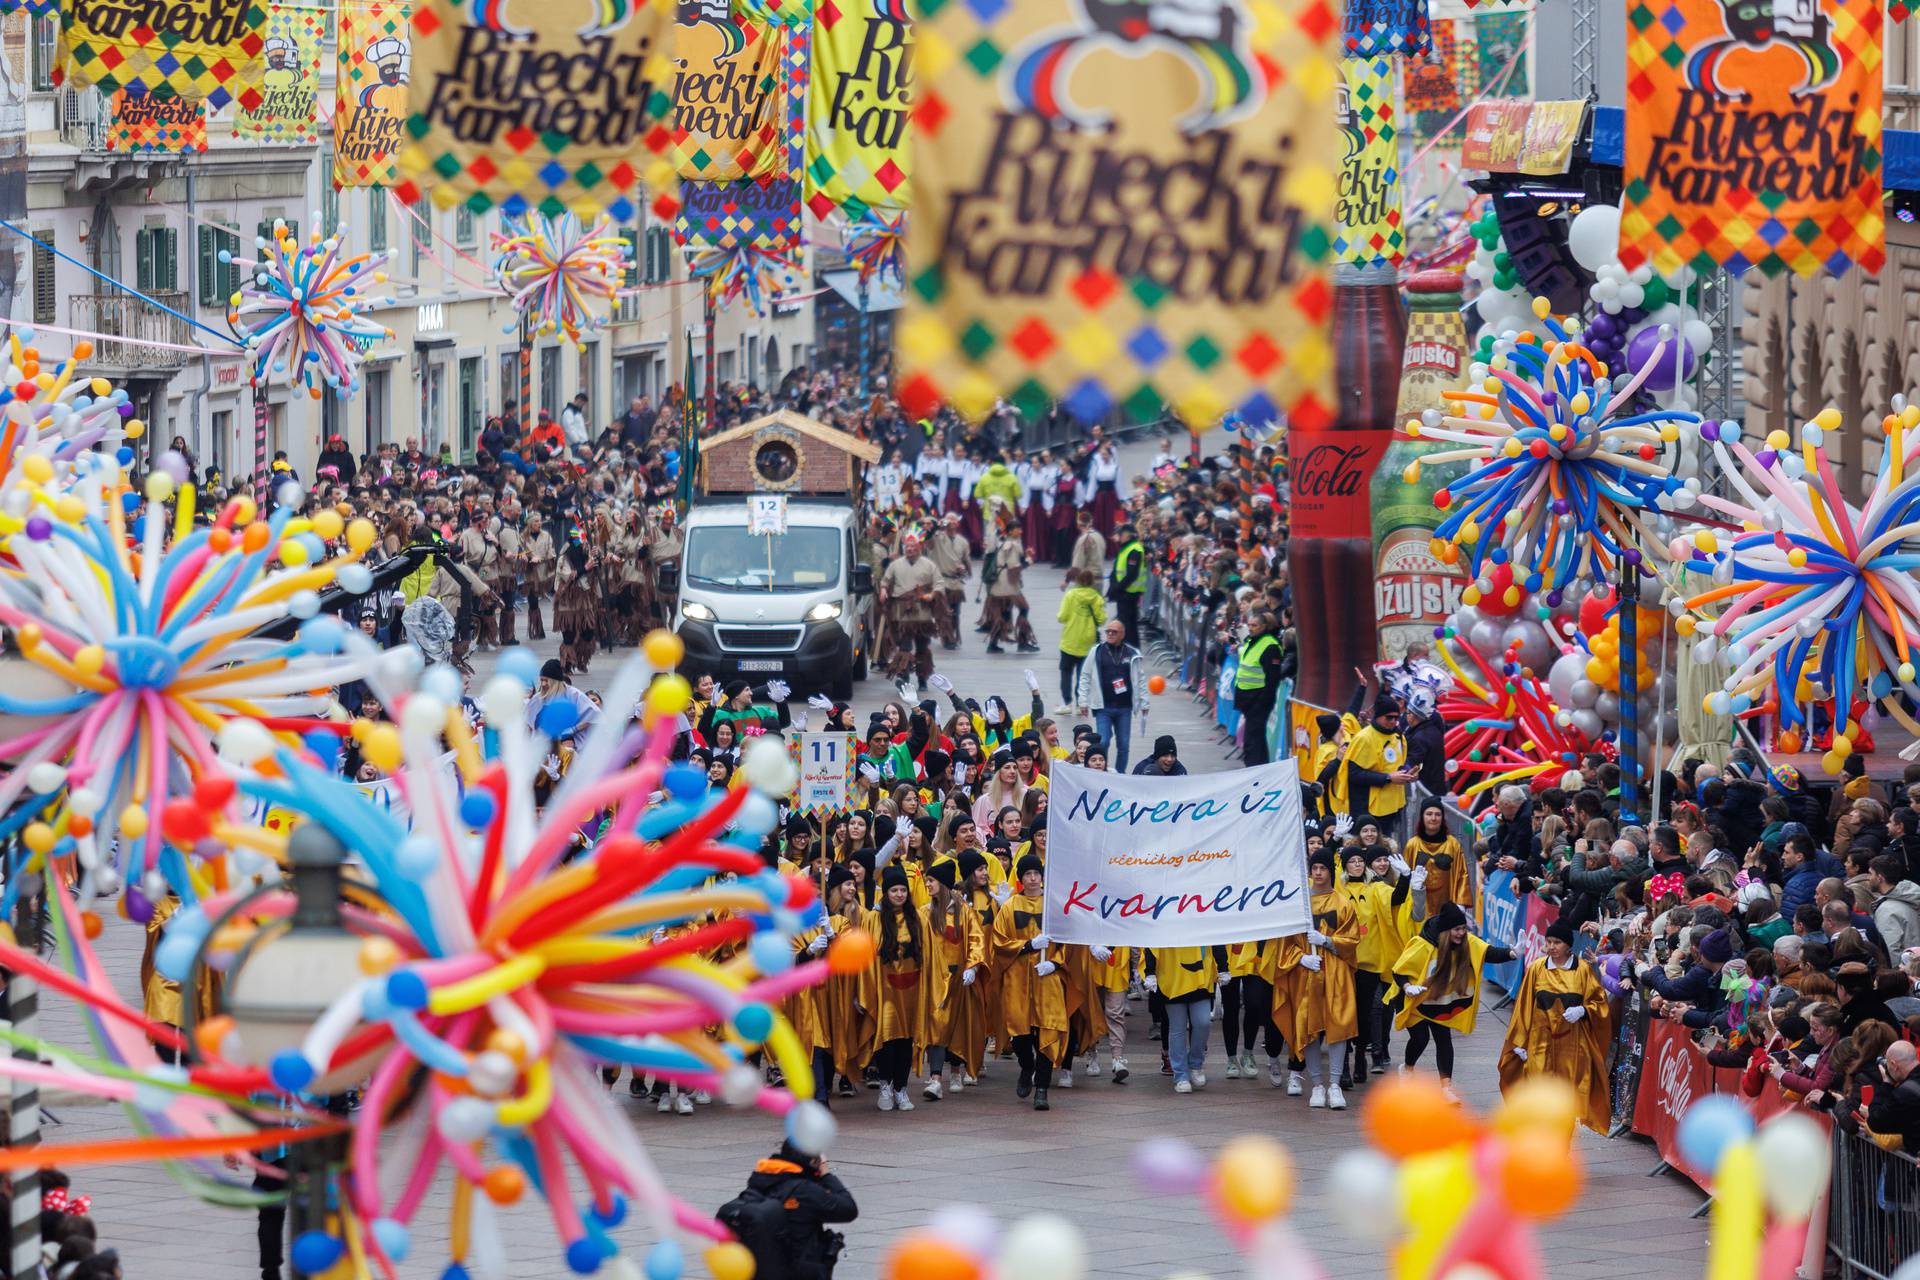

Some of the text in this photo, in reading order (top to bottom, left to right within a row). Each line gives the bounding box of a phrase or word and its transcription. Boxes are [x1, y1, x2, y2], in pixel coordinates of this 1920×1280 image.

[424, 73, 655, 147] karneval
[673, 92, 765, 140] neval
[1669, 88, 1860, 166] Riječki
[339, 129, 404, 161] karne
[1643, 135, 1868, 207] karneval
[417, 303, 444, 332] DAKA
[759, 500, 777, 511] 12
[1375, 574, 1464, 621] Ožujsk
[811, 741, 836, 762] 11
[1068, 781, 1283, 826] Nevera iz
[1187, 848, 1232, 862] doma
[1063, 879, 1300, 920] Kvarnera
